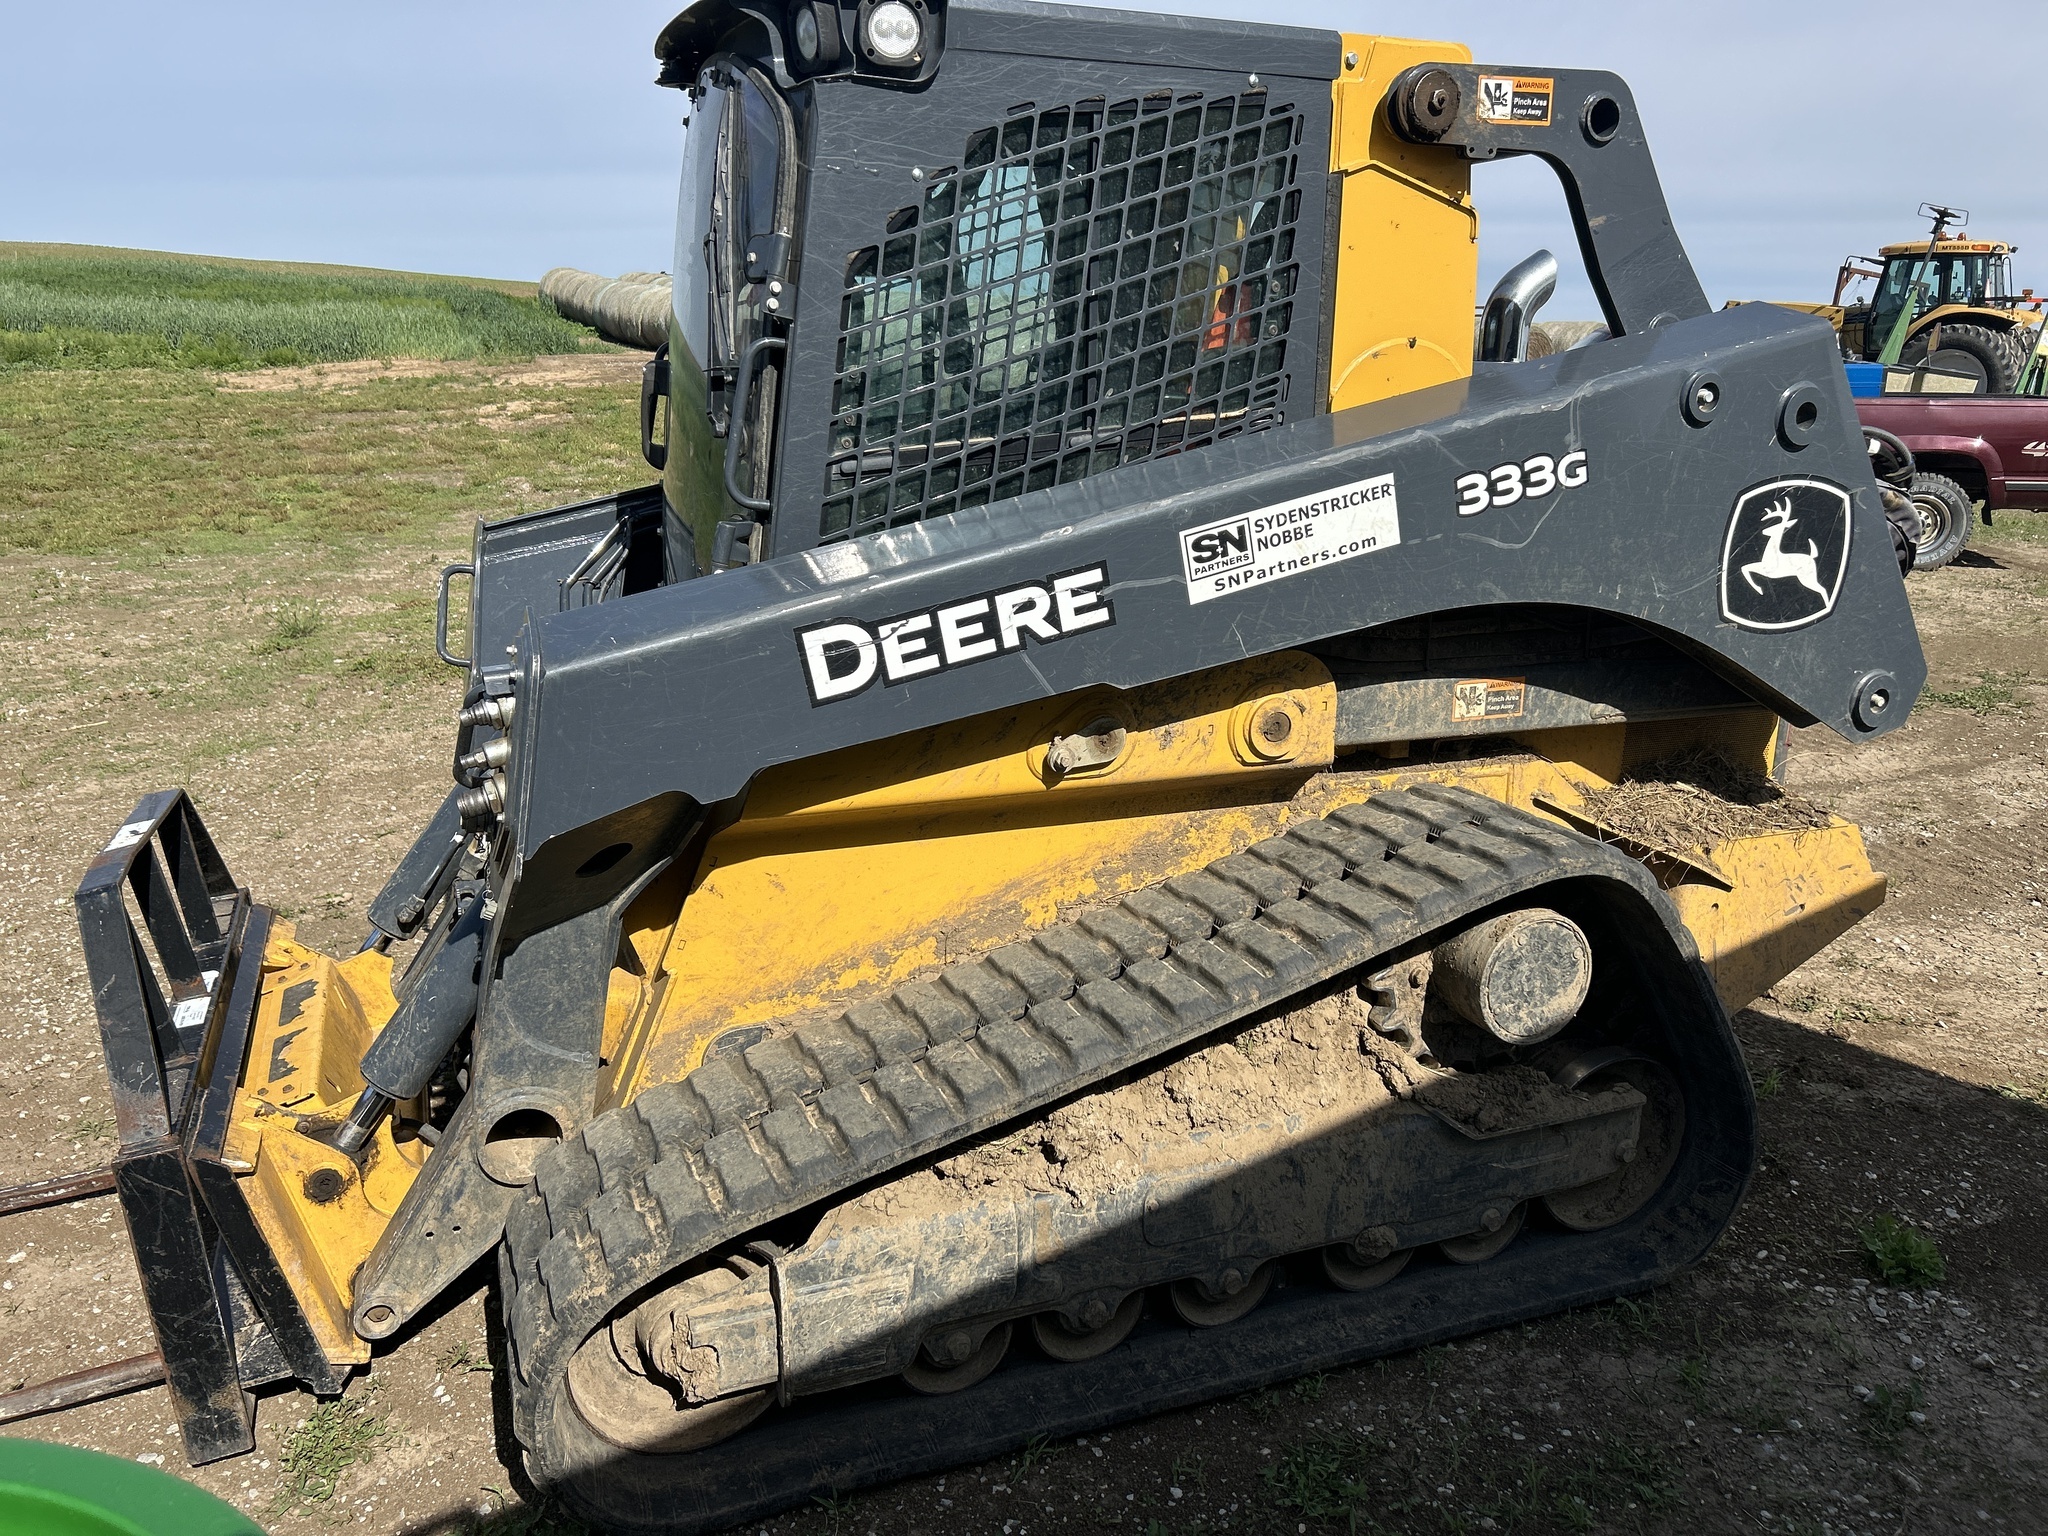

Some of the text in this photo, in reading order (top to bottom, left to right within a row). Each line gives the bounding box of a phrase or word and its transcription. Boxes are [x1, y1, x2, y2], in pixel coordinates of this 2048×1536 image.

[1522, 81, 1549, 89] WARNING
[1513, 107, 1542, 117] Keep Away
[1514, 97, 1547, 107] Pinch Area
[2021, 440, 2048, 457] 4
[1455, 450, 1588, 516] 333G
[1254, 483, 1392, 533] SYDENSTRICKER
[1257, 523, 1314, 552] NOBBE
[1194, 553, 1250, 576] PARTNERS
[1214, 535, 1378, 592] SNPartners.com
[801, 567, 1110, 700] DEERE
[1488, 694, 1520, 703] Pinch Area
